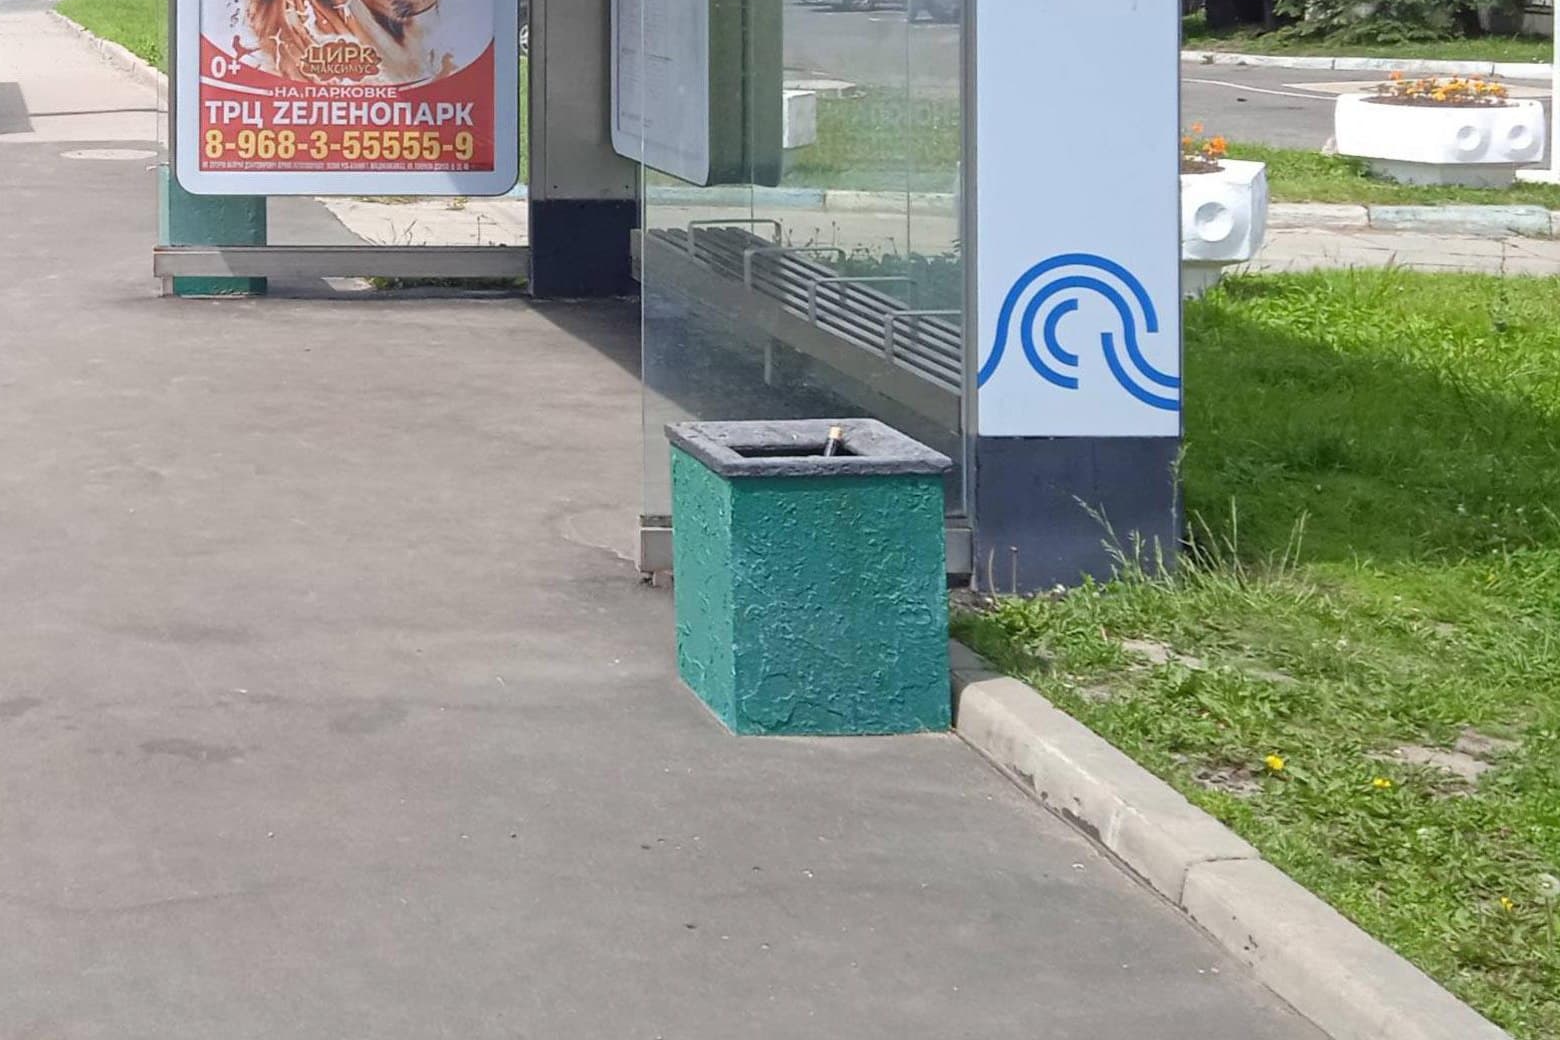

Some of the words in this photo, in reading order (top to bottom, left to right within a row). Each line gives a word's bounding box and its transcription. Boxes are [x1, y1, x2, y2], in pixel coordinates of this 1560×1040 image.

[308, 47, 374, 65] ЦИРК
[210, 56, 241, 78] 0+
[310, 64, 372, 75] МАКСИМУС
[304, 87, 397, 99] ПАРКОВКЕ
[205, 101, 263, 129] ТРЦ
[273, 101, 474, 127] ZЕЛЕНОПАРК
[205, 129, 474, 160] 8-968-3-55555-9
